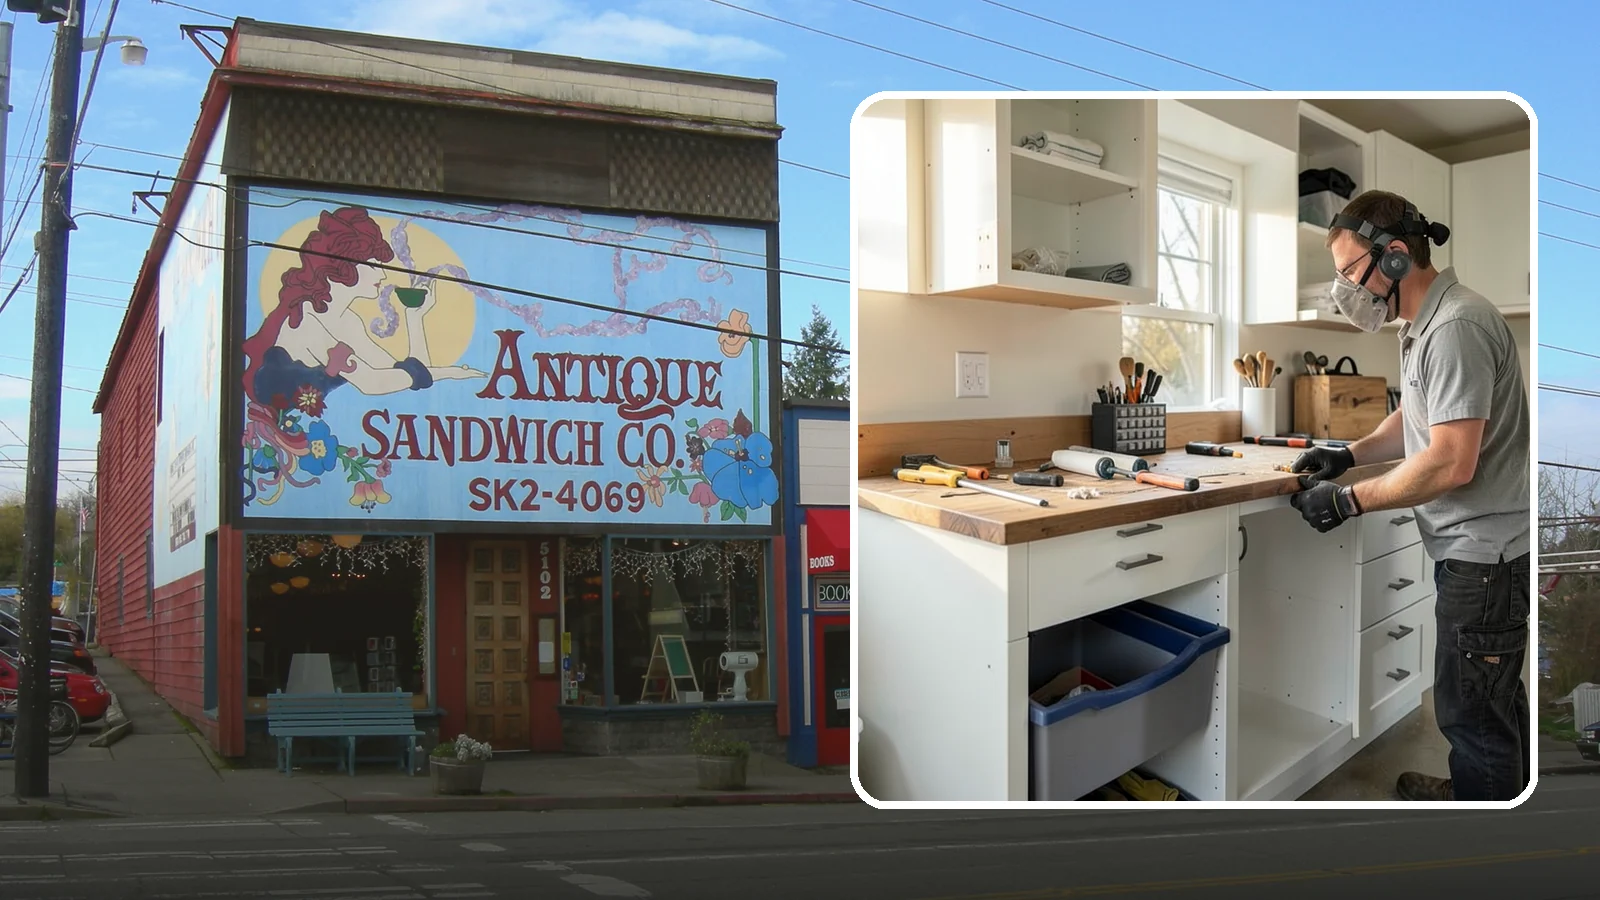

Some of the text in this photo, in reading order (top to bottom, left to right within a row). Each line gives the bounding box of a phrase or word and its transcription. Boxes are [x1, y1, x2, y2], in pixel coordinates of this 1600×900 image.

[475, 328, 724, 420] ANTIQUE
[361, 408, 686, 469] SANDWICH CO.
[468, 478, 646, 514] SK2-4069
[539, 541, 552, 600] 5102
[809, 555, 835, 569] BOOKS
